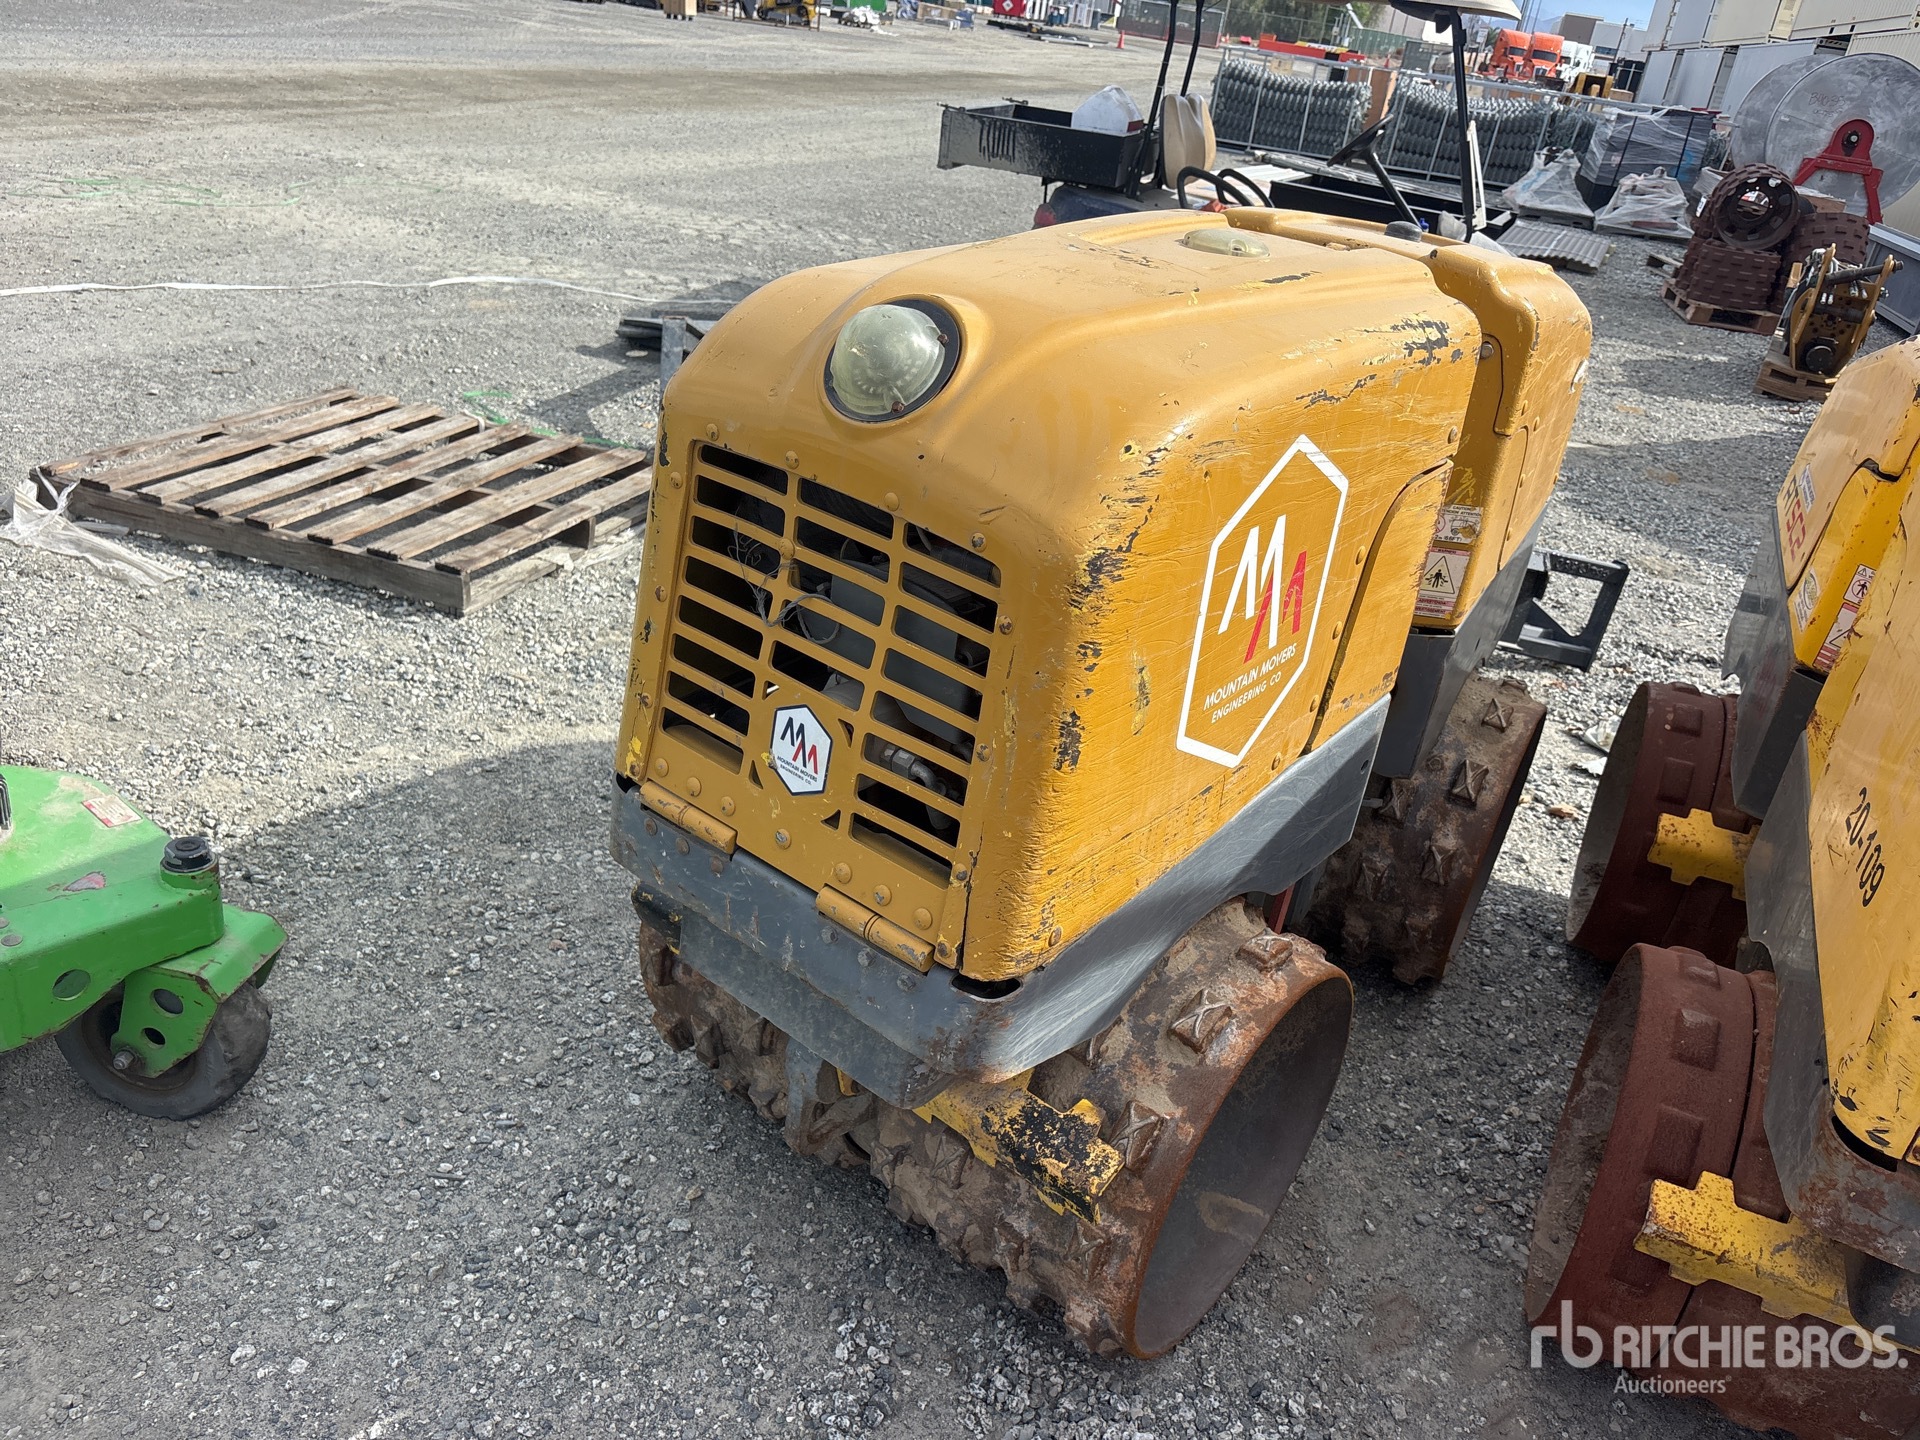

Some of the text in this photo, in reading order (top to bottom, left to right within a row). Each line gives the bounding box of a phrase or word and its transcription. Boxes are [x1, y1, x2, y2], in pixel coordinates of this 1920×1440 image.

[1204, 643, 1298, 711] MOUNTAIN MOVERS
[1211, 671, 1282, 724] ENGINEERING CO
[777, 755, 818, 782] MOUNTAIN MOVERS
[780, 764, 804, 781] ENGINEERING
[1845, 786, 1885, 908] 20-109
